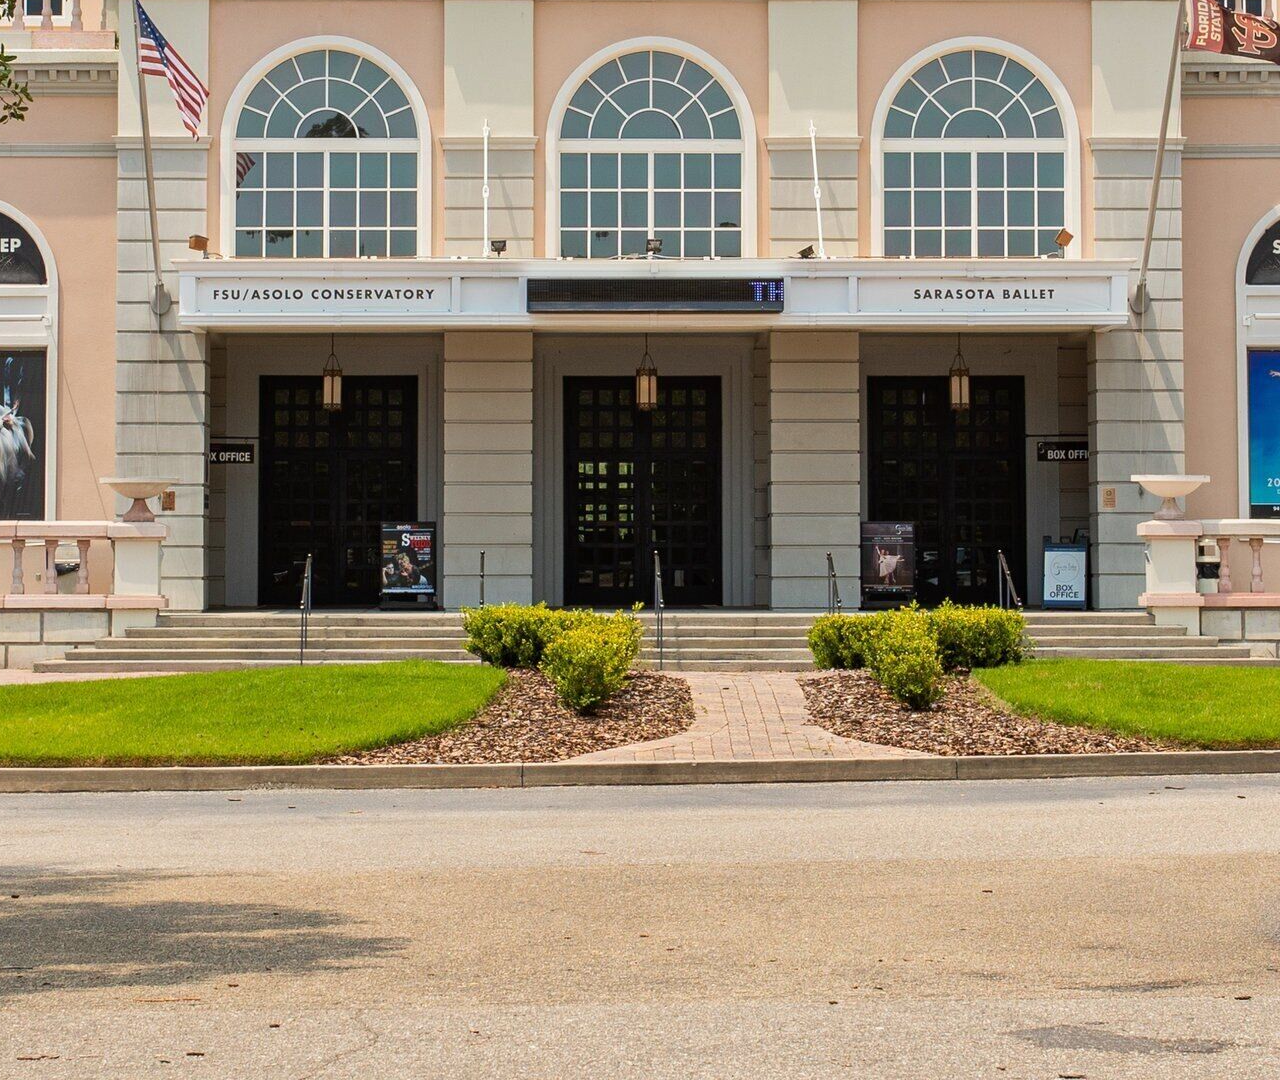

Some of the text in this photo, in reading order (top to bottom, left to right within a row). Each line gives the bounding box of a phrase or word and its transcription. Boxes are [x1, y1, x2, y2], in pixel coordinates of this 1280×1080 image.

[213, 289, 435, 301] FSU/ASOLO CONSERVATORY
[913, 289, 1055, 300] SARASOTA BALLET
[219, 452, 251, 461] OFFICE
[1047, 450, 1090, 459] BOX OFFI
[1055, 584, 1074, 592] BOX
[1049, 591, 1080, 599] OFFICE
